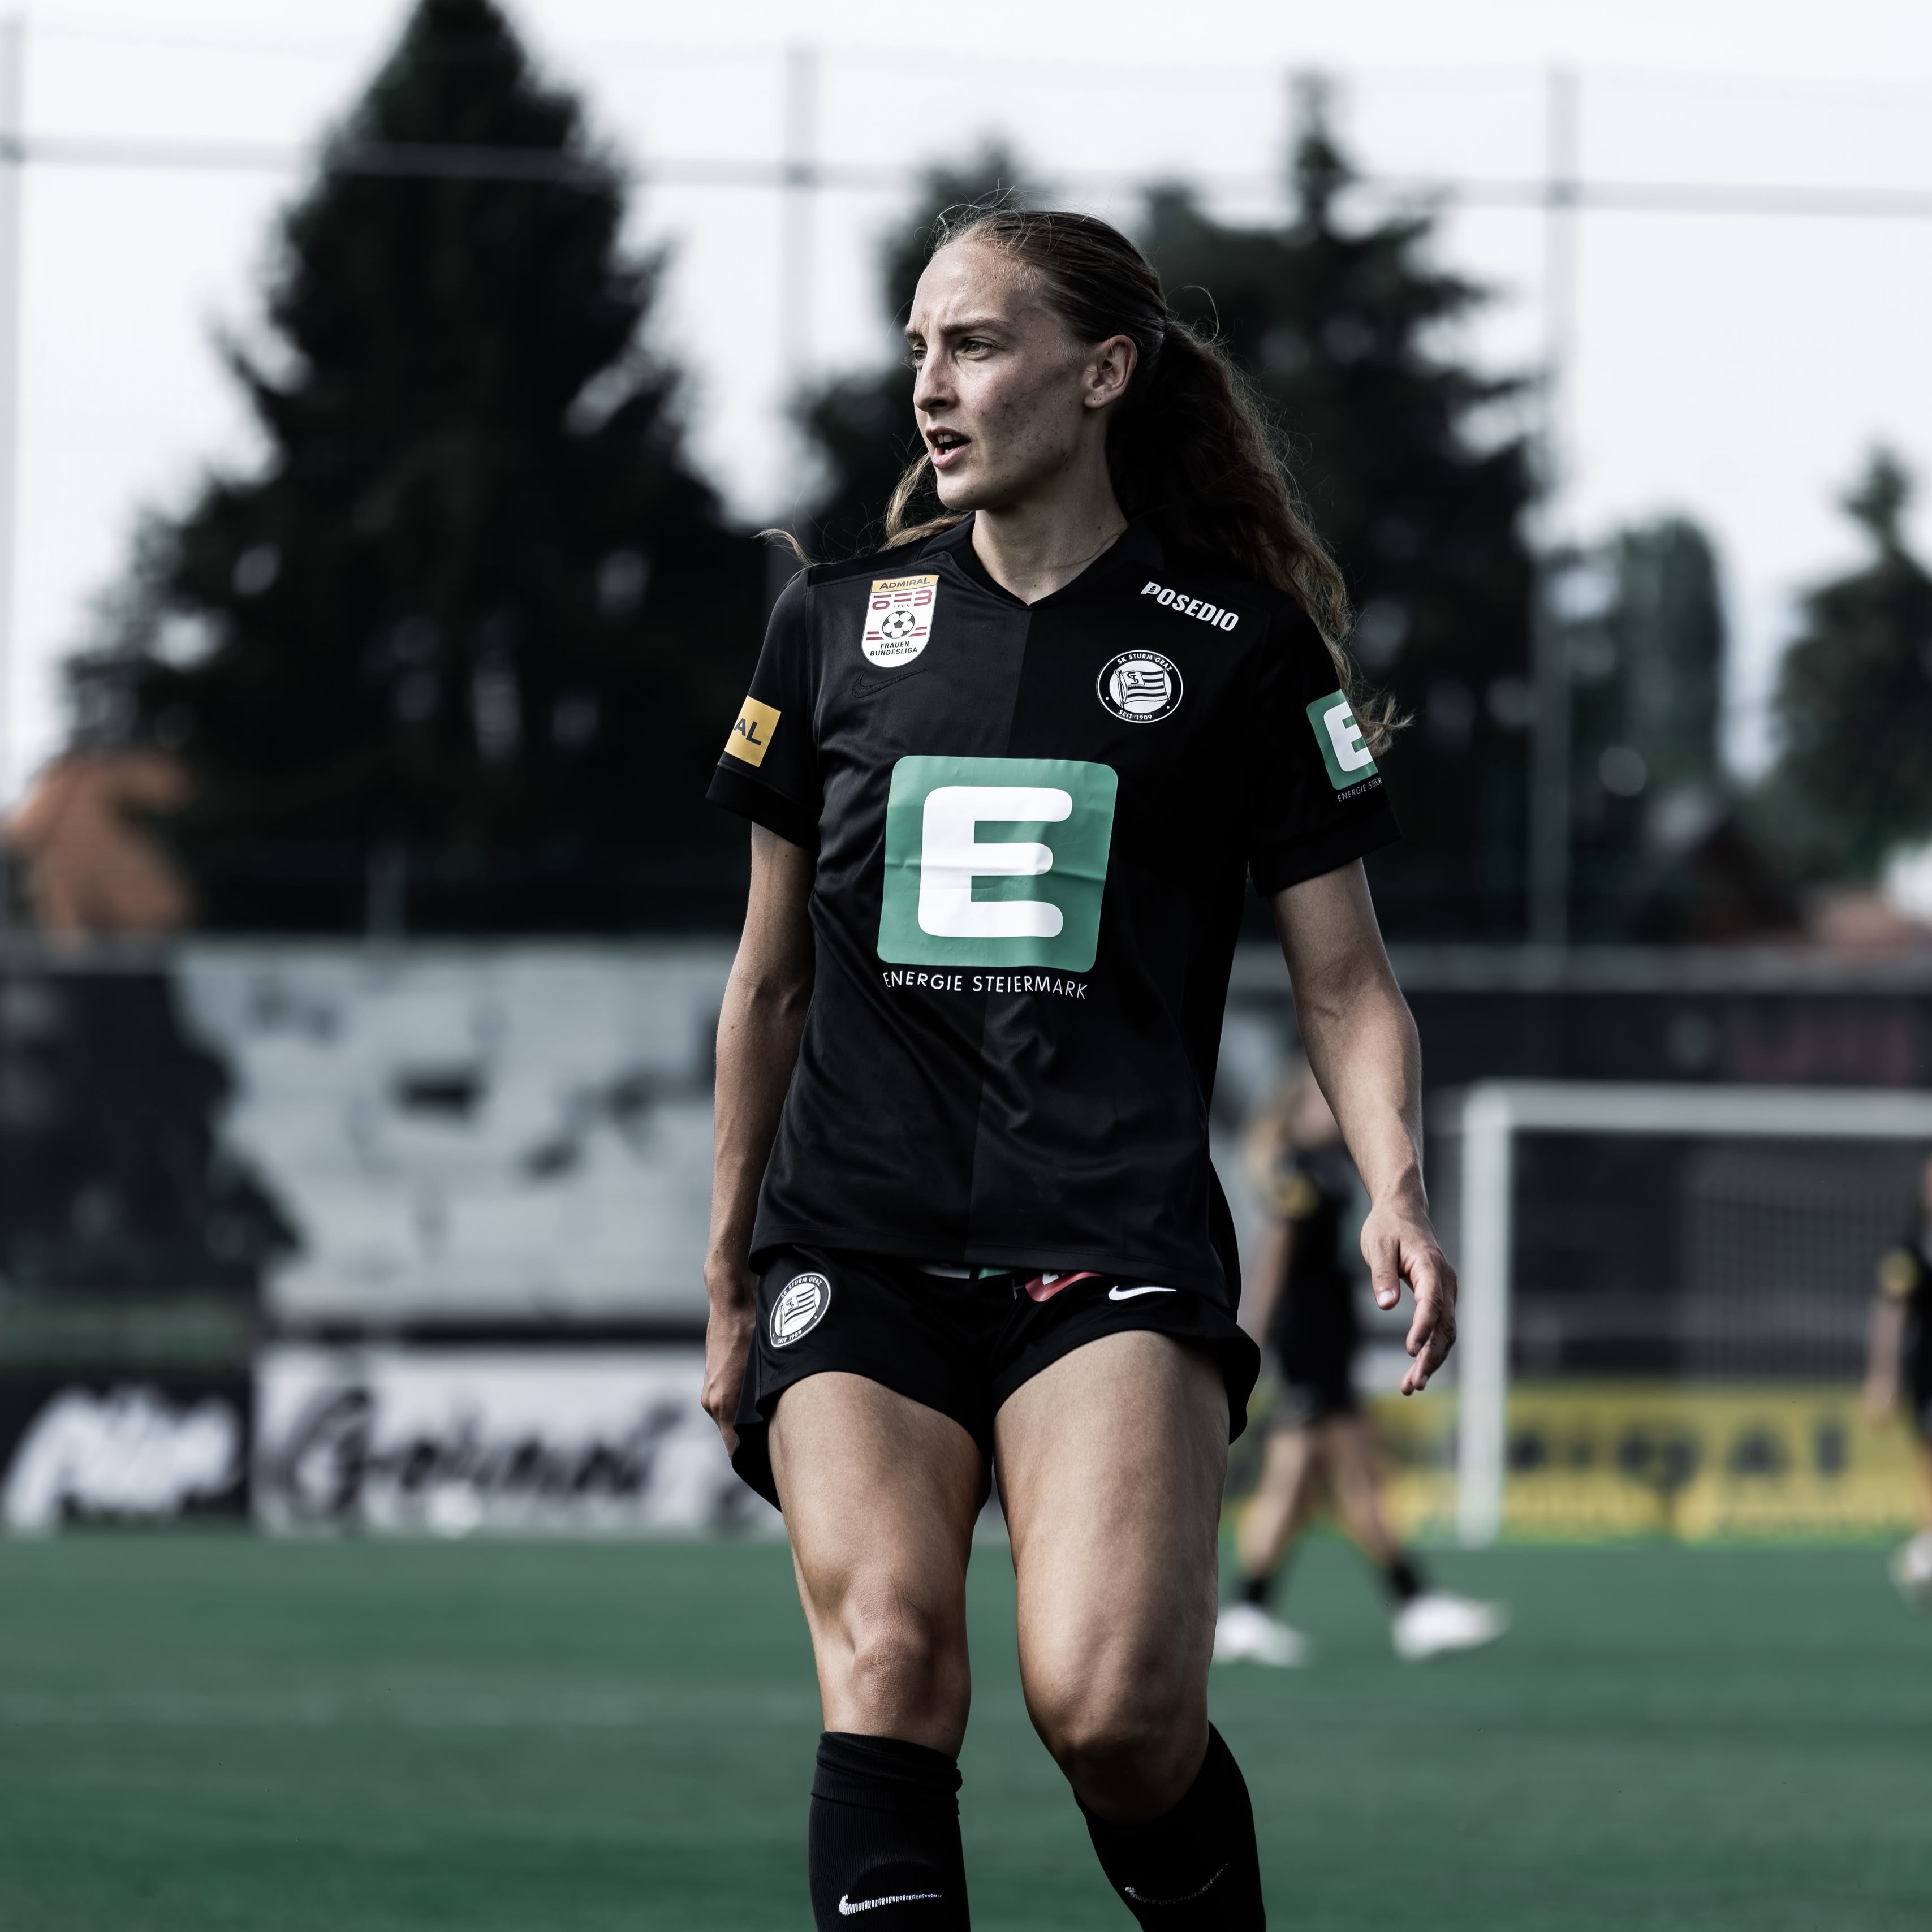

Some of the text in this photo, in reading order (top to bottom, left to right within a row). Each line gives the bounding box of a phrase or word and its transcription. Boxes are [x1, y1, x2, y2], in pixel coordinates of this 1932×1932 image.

[879, 577, 930, 589] ADMIRAL
[1140, 581, 1239, 631] POSEDIO
[870, 647, 917, 656] BUNDESLIGA
[1155, 657, 1172, 672] GRAZ
[1118, 710, 1132, 719] SEIT
[1337, 784, 1366, 802] ENERGIE
[918, 786, 1073, 938] E
[883, 970, 1088, 999] ENERGIE STEIERMARK
[788, 1277, 807, 1290] STURM
[809, 1276, 822, 1287] GRAZ
[789, 1330, 802, 1340] 1909
